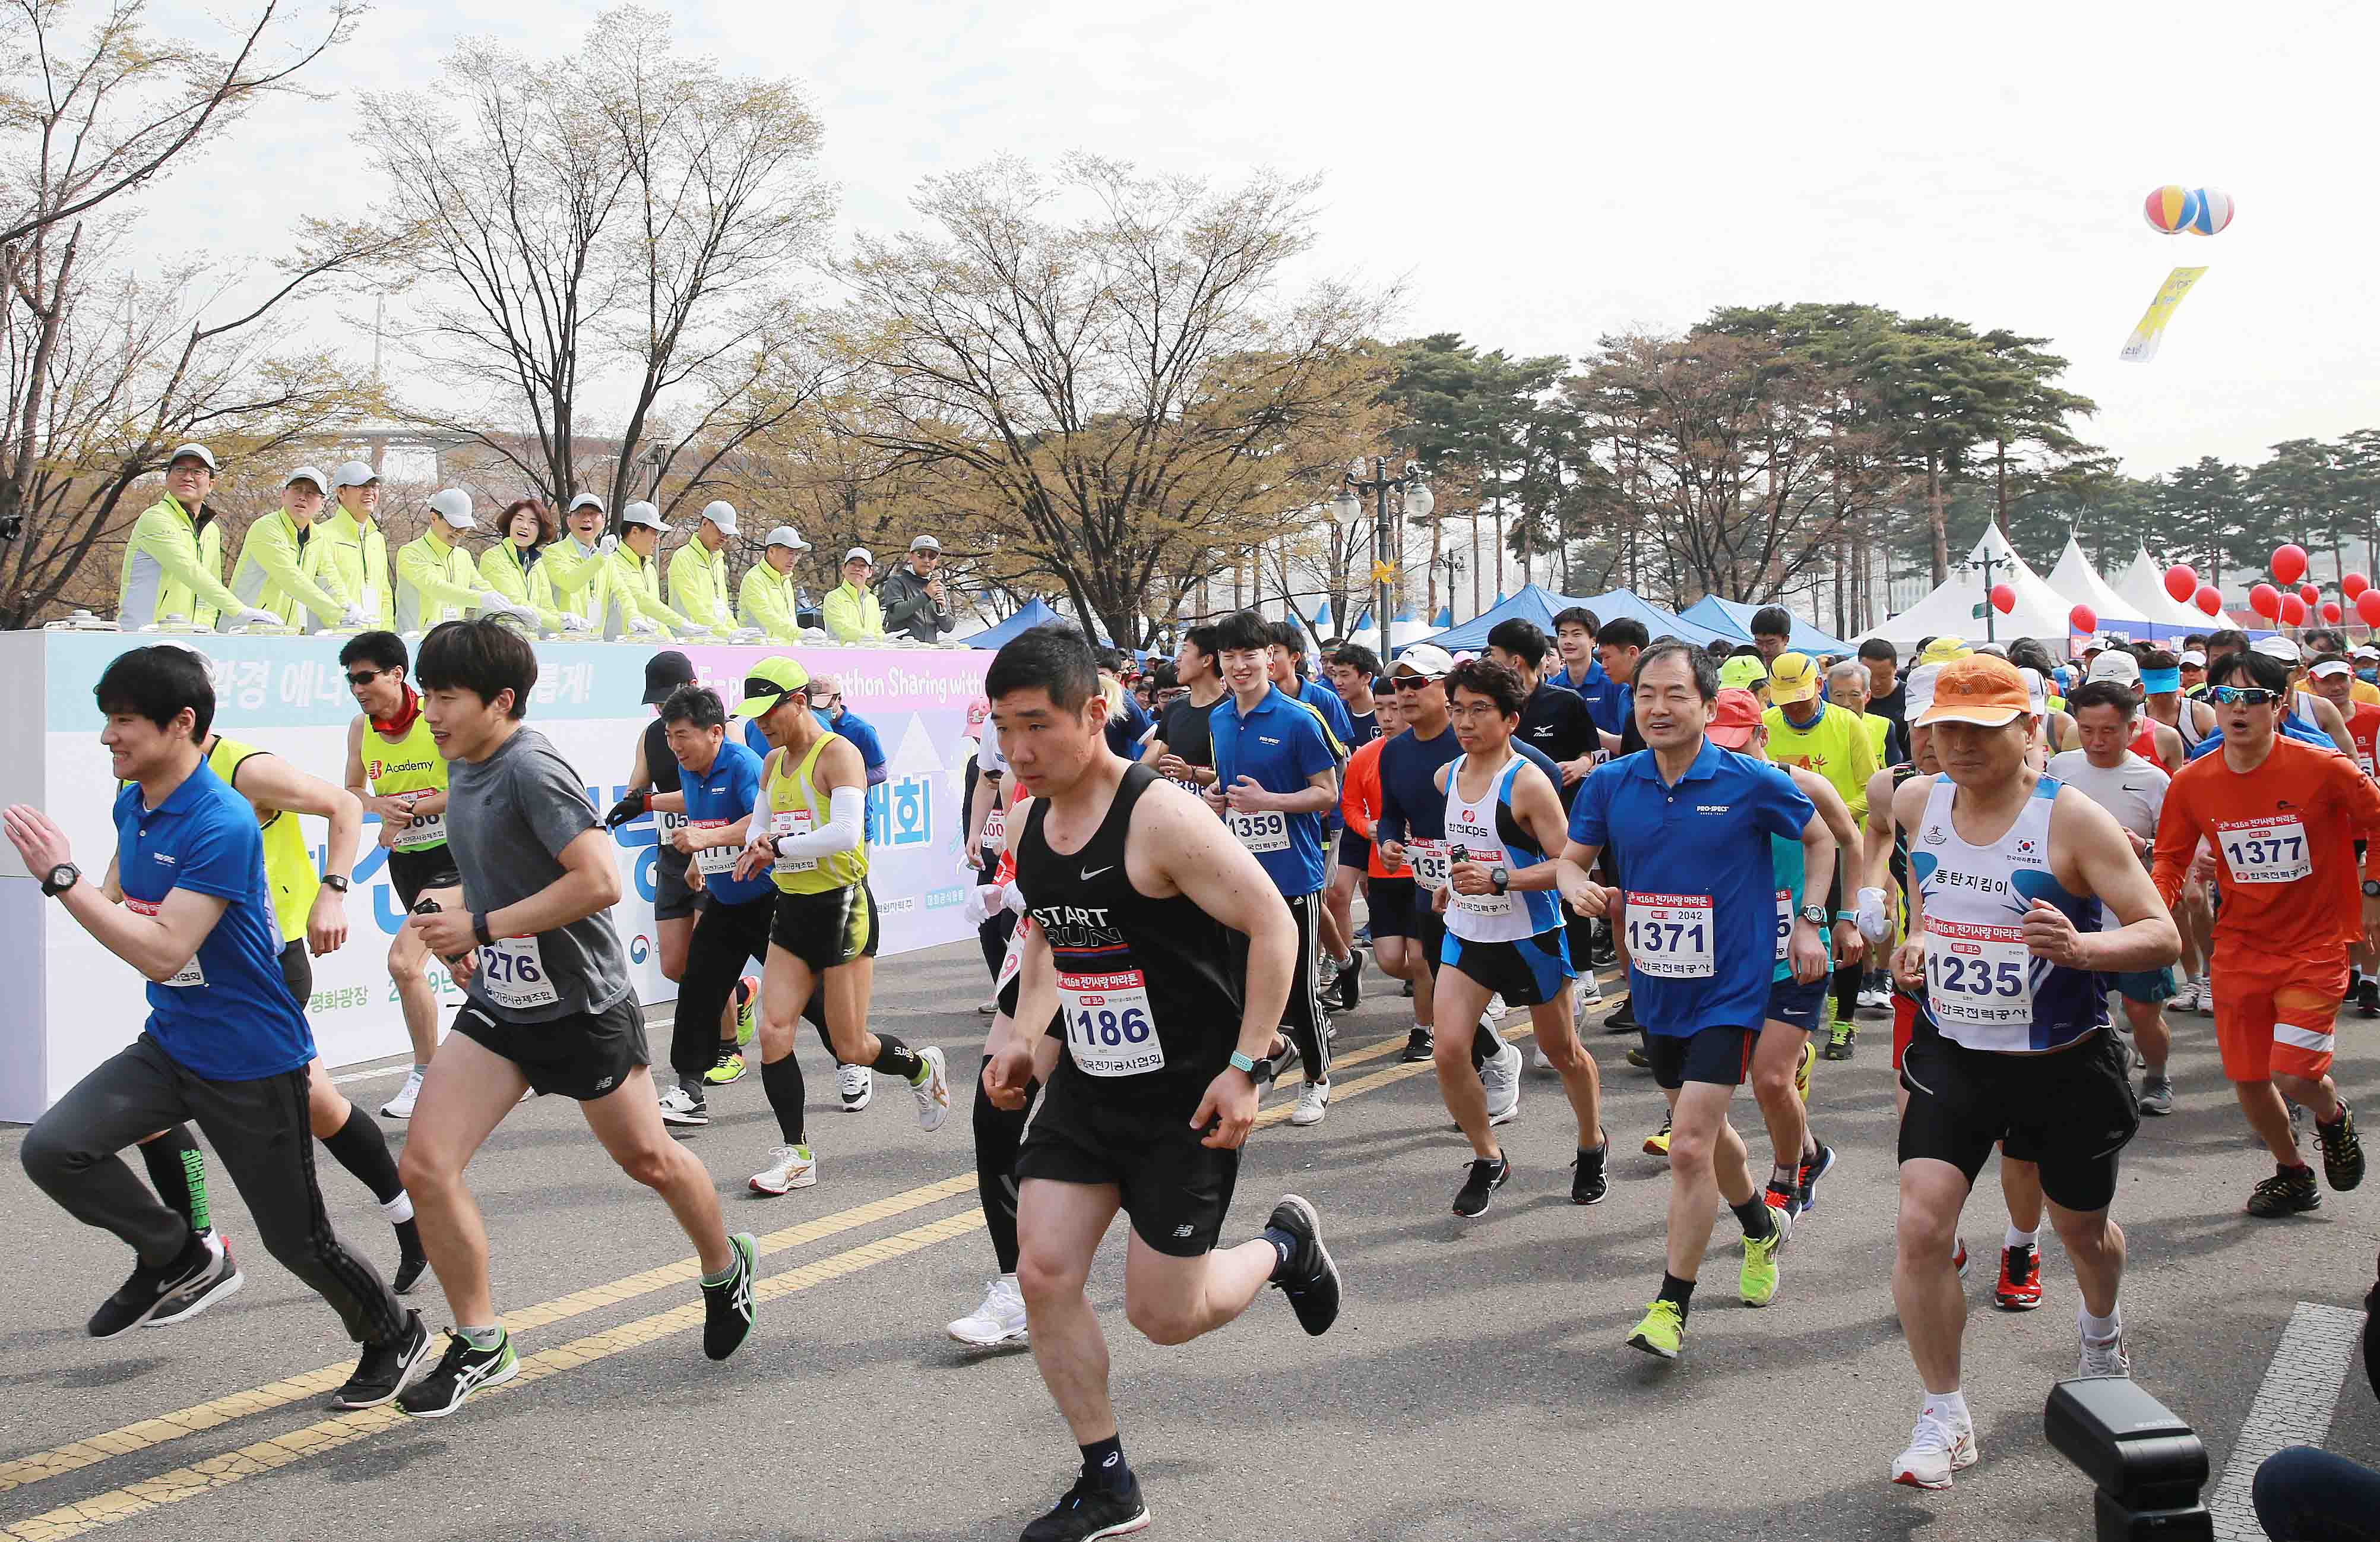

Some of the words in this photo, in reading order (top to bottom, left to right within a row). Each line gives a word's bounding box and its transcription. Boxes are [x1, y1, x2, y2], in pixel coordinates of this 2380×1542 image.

[888, 665, 947, 703] Sharing
[951, 669, 981, 695] with
[385, 759, 434, 775] Academy
[1229, 815, 1283, 838] 1359
[1243, 840, 1288, 851] 국전력공사
[2228, 836, 2302, 865] 1377
[1935, 869, 2008, 896] 동탄지킴이
[2250, 865, 2309, 880] 한국전력공사
[1655, 895, 1683, 906] 전기사랑
[1684, 896, 1708, 906] 마라톤
[1032, 906, 1108, 927] START
[1678, 911, 1702, 920] 2042
[1045, 926, 1125, 947] RUN
[1629, 921, 1704, 953] 1371
[1957, 924, 1992, 940] 전기사랑
[1993, 927, 2024, 941] 마라톤
[1642, 960, 1710, 974] 한국전력공사
[1928, 952, 2023, 997] 1235
[1080, 976, 1109, 989] 전기사랑
[1110, 973, 1138, 986] 마라톤
[310, 984, 369, 1014] 평화광장
[1941, 1002, 2028, 1020] 한국전력공사
[1066, 1007, 1150, 1046] 1186
